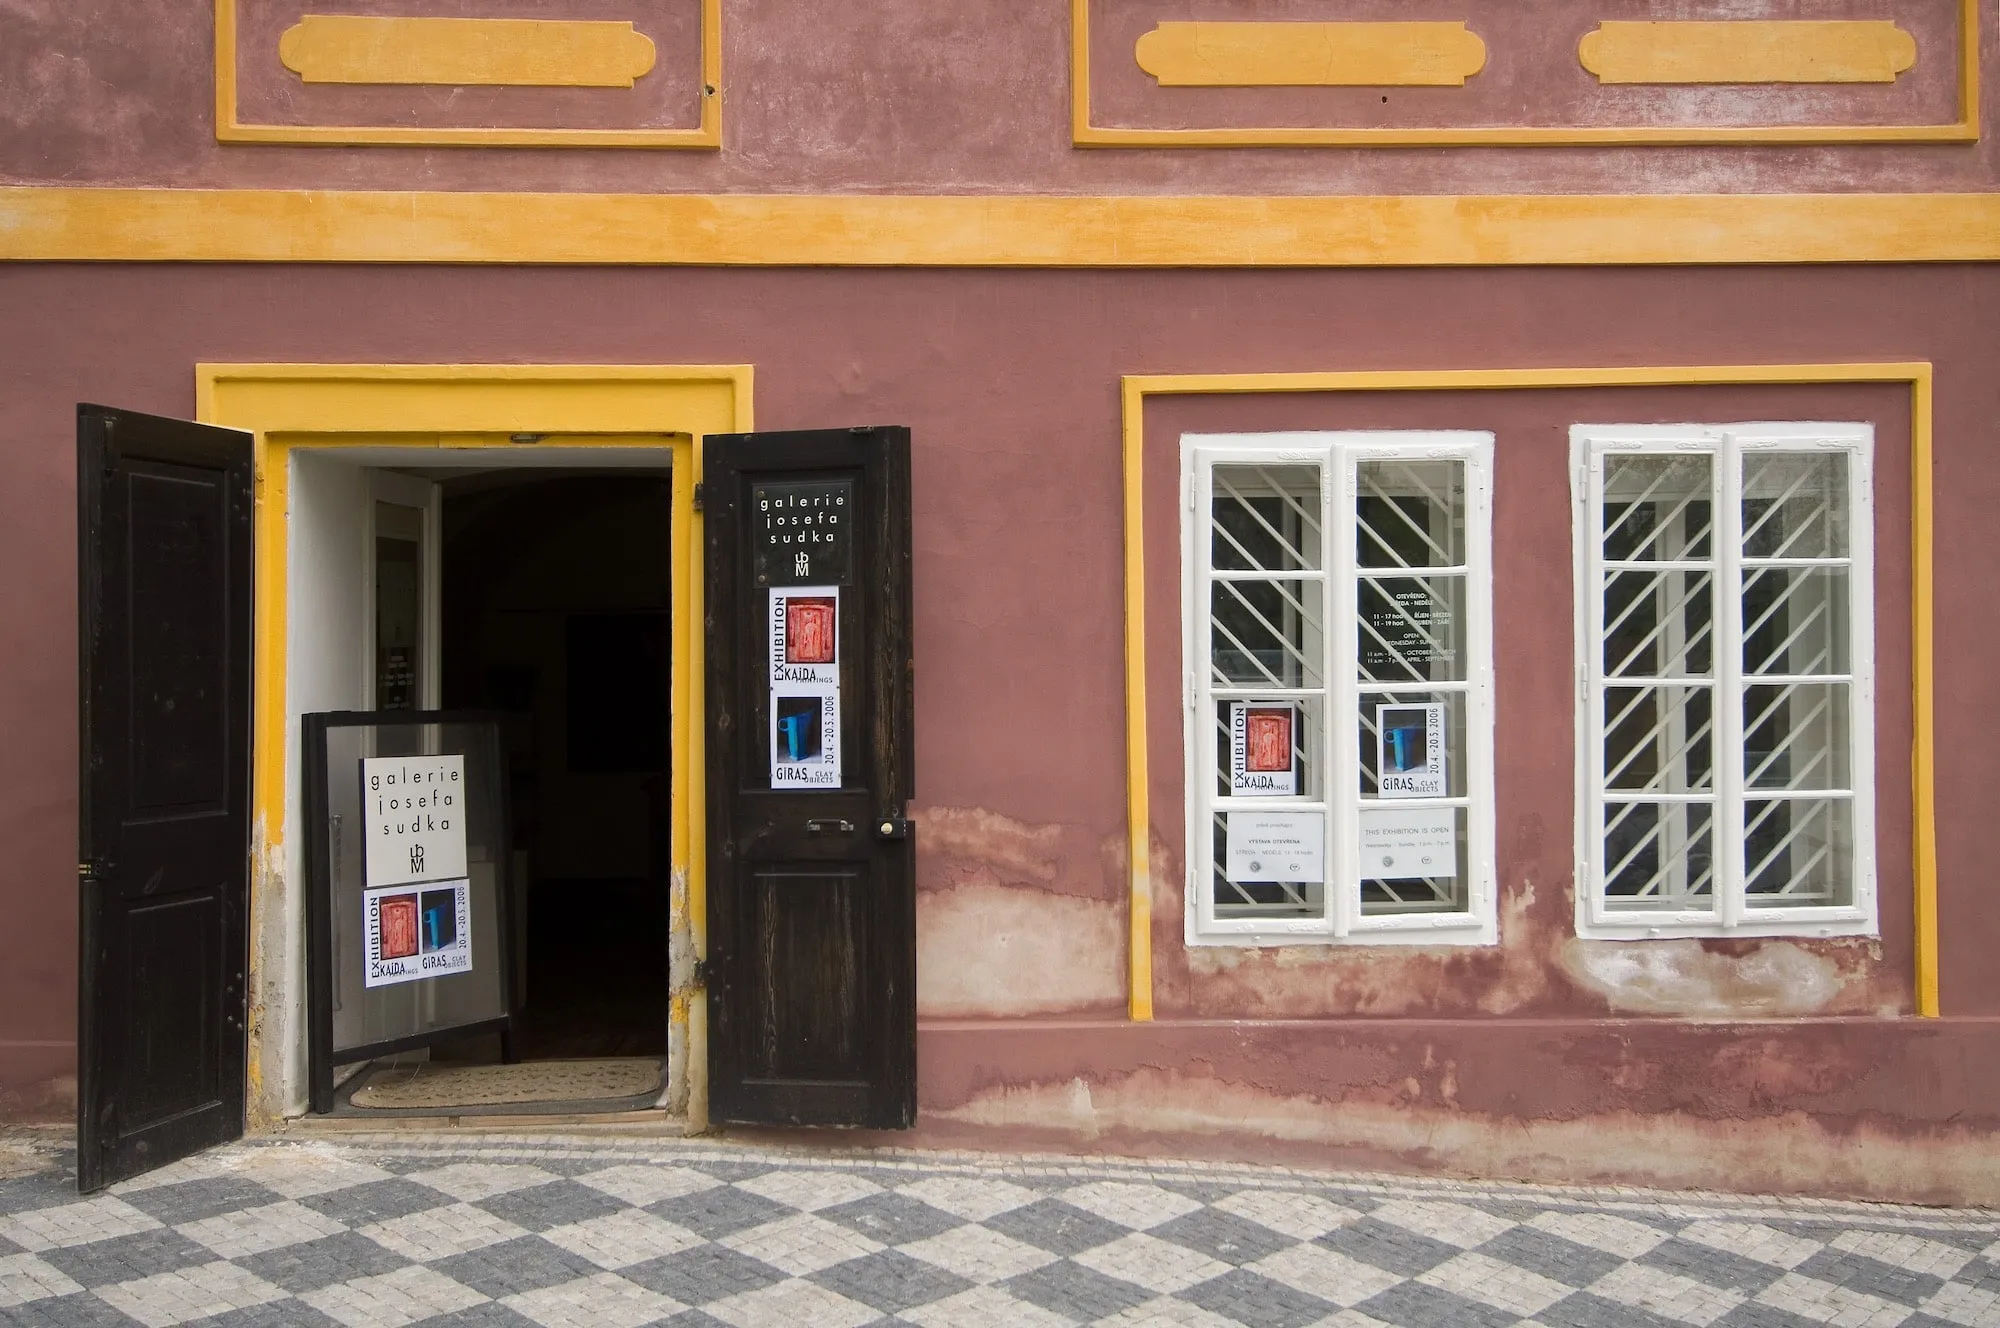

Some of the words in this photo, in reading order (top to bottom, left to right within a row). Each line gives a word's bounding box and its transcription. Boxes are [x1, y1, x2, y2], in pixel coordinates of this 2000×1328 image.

[760, 493, 844, 511] galerie
[766, 511, 837, 529] josefa
[770, 530, 834, 544] sudka
[774, 597, 785, 681] EXHIBITION
[1234, 708, 1244, 788] EXHIBITION
[371, 766, 458, 791] galerie
[804, 776, 834, 784] OBJECTS
[379, 789, 452, 815] josefa
[383, 814, 449, 835] sudka
[1382, 827, 1419, 836] EXHIBITION
[1430, 826, 1449, 834] OPEN
[370, 897, 380, 979] EXHIBITION
